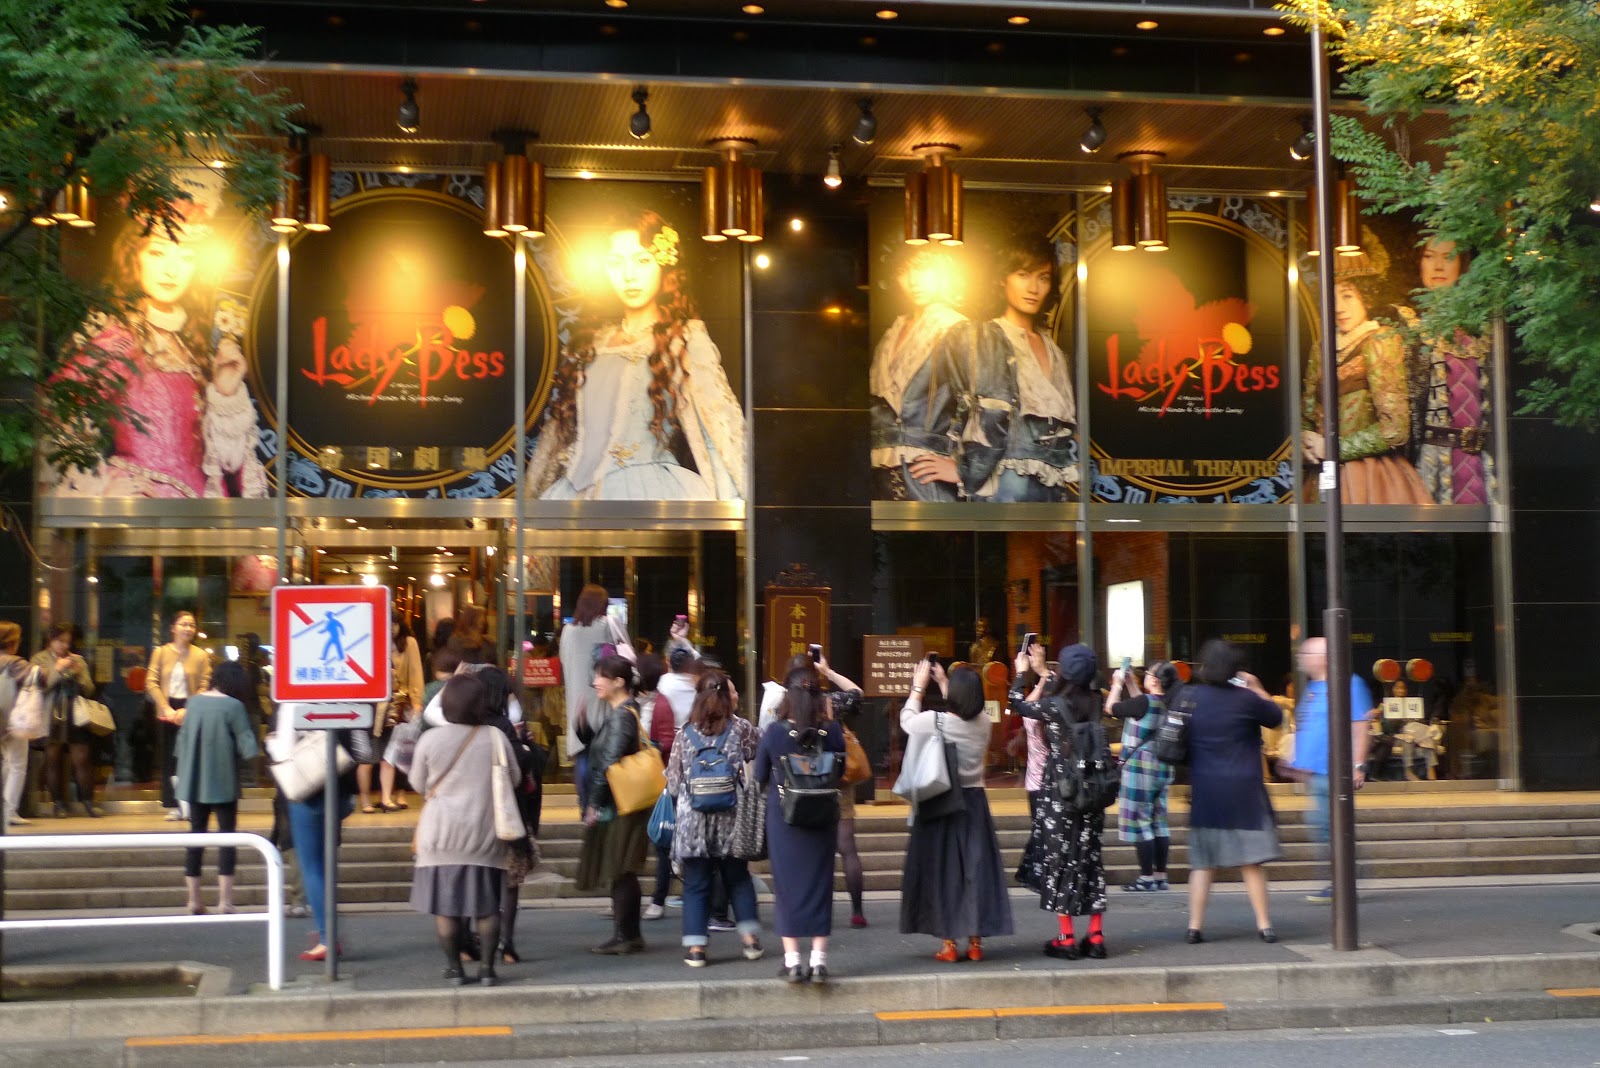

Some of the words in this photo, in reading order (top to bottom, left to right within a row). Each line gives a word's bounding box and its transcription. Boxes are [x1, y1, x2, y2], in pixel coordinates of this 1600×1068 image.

[301, 316, 403, 408] Lady
[407, 320, 505, 409] Bess
[1097, 333, 1192, 419] Lady
[1193, 337, 1280, 420] Bess
[1099, 458, 1189, 476] IMPERIAL
[1193, 459, 1278, 477] THEATRE
[295, 666, 349, 681] 横断禁止
